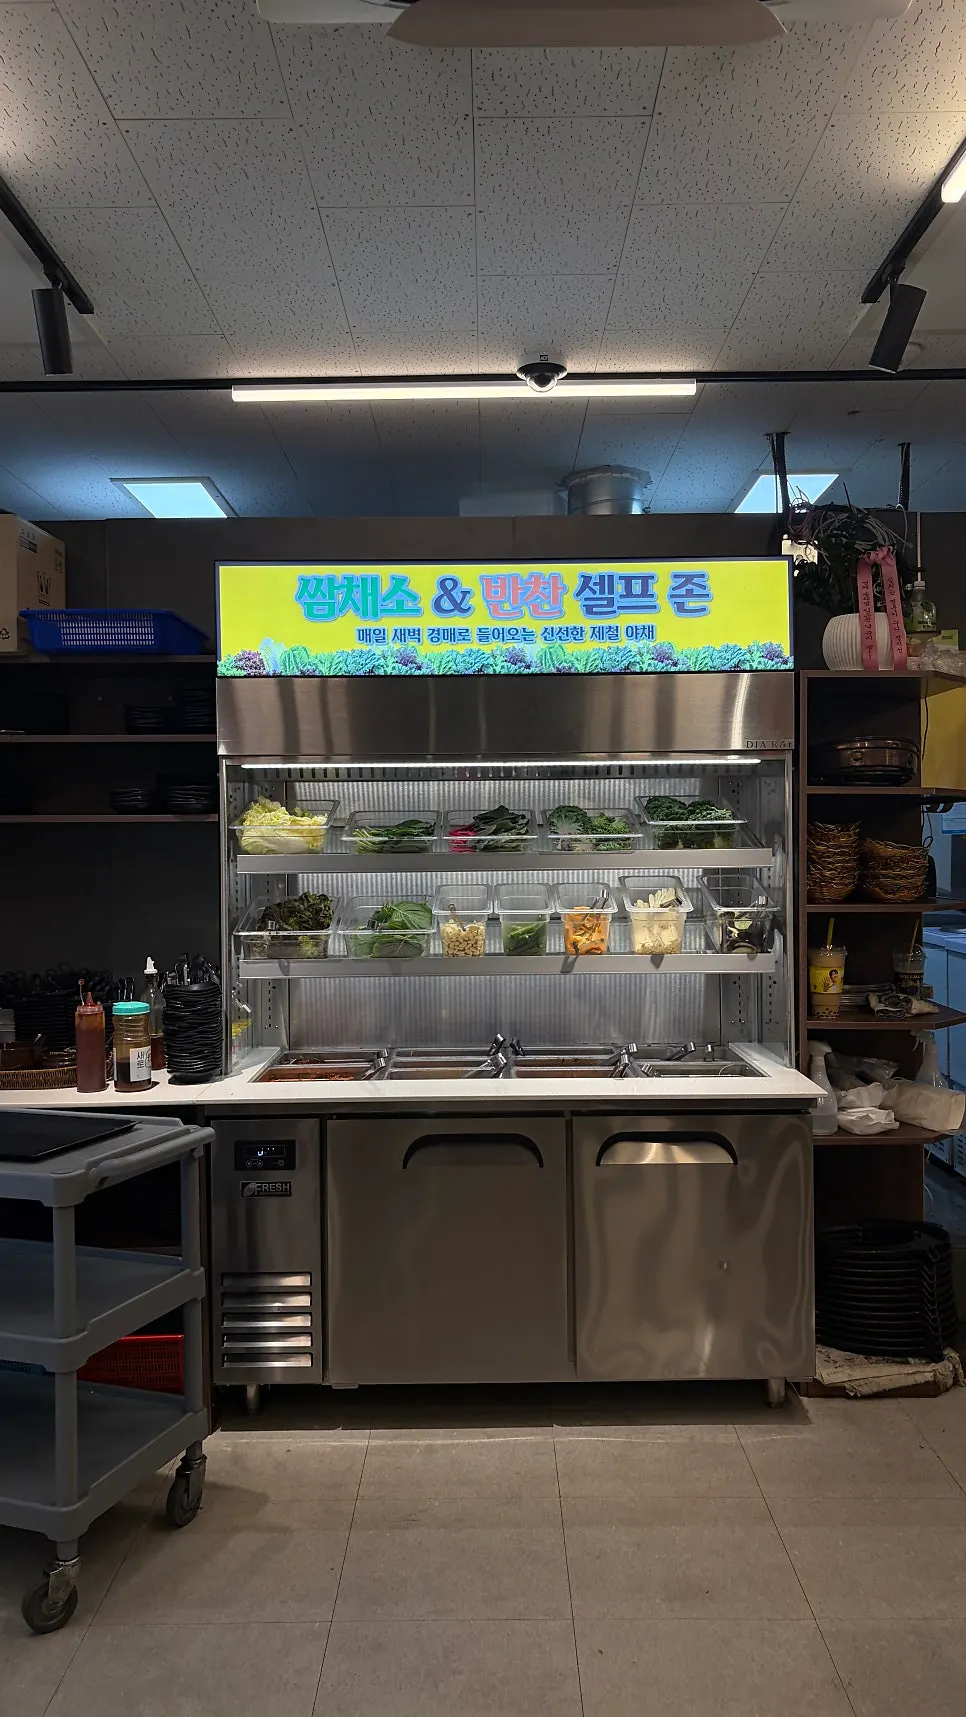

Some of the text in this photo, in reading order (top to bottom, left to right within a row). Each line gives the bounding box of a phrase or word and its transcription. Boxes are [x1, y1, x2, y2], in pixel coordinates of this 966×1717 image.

[296, 572, 712, 620] 쌈채소 & 반찬 셀프 존
[357, 624, 656, 644] 매일 새벽 경매로 들어오는 신선한 제철 야채
[254, 1183, 290, 1195] FRESH
